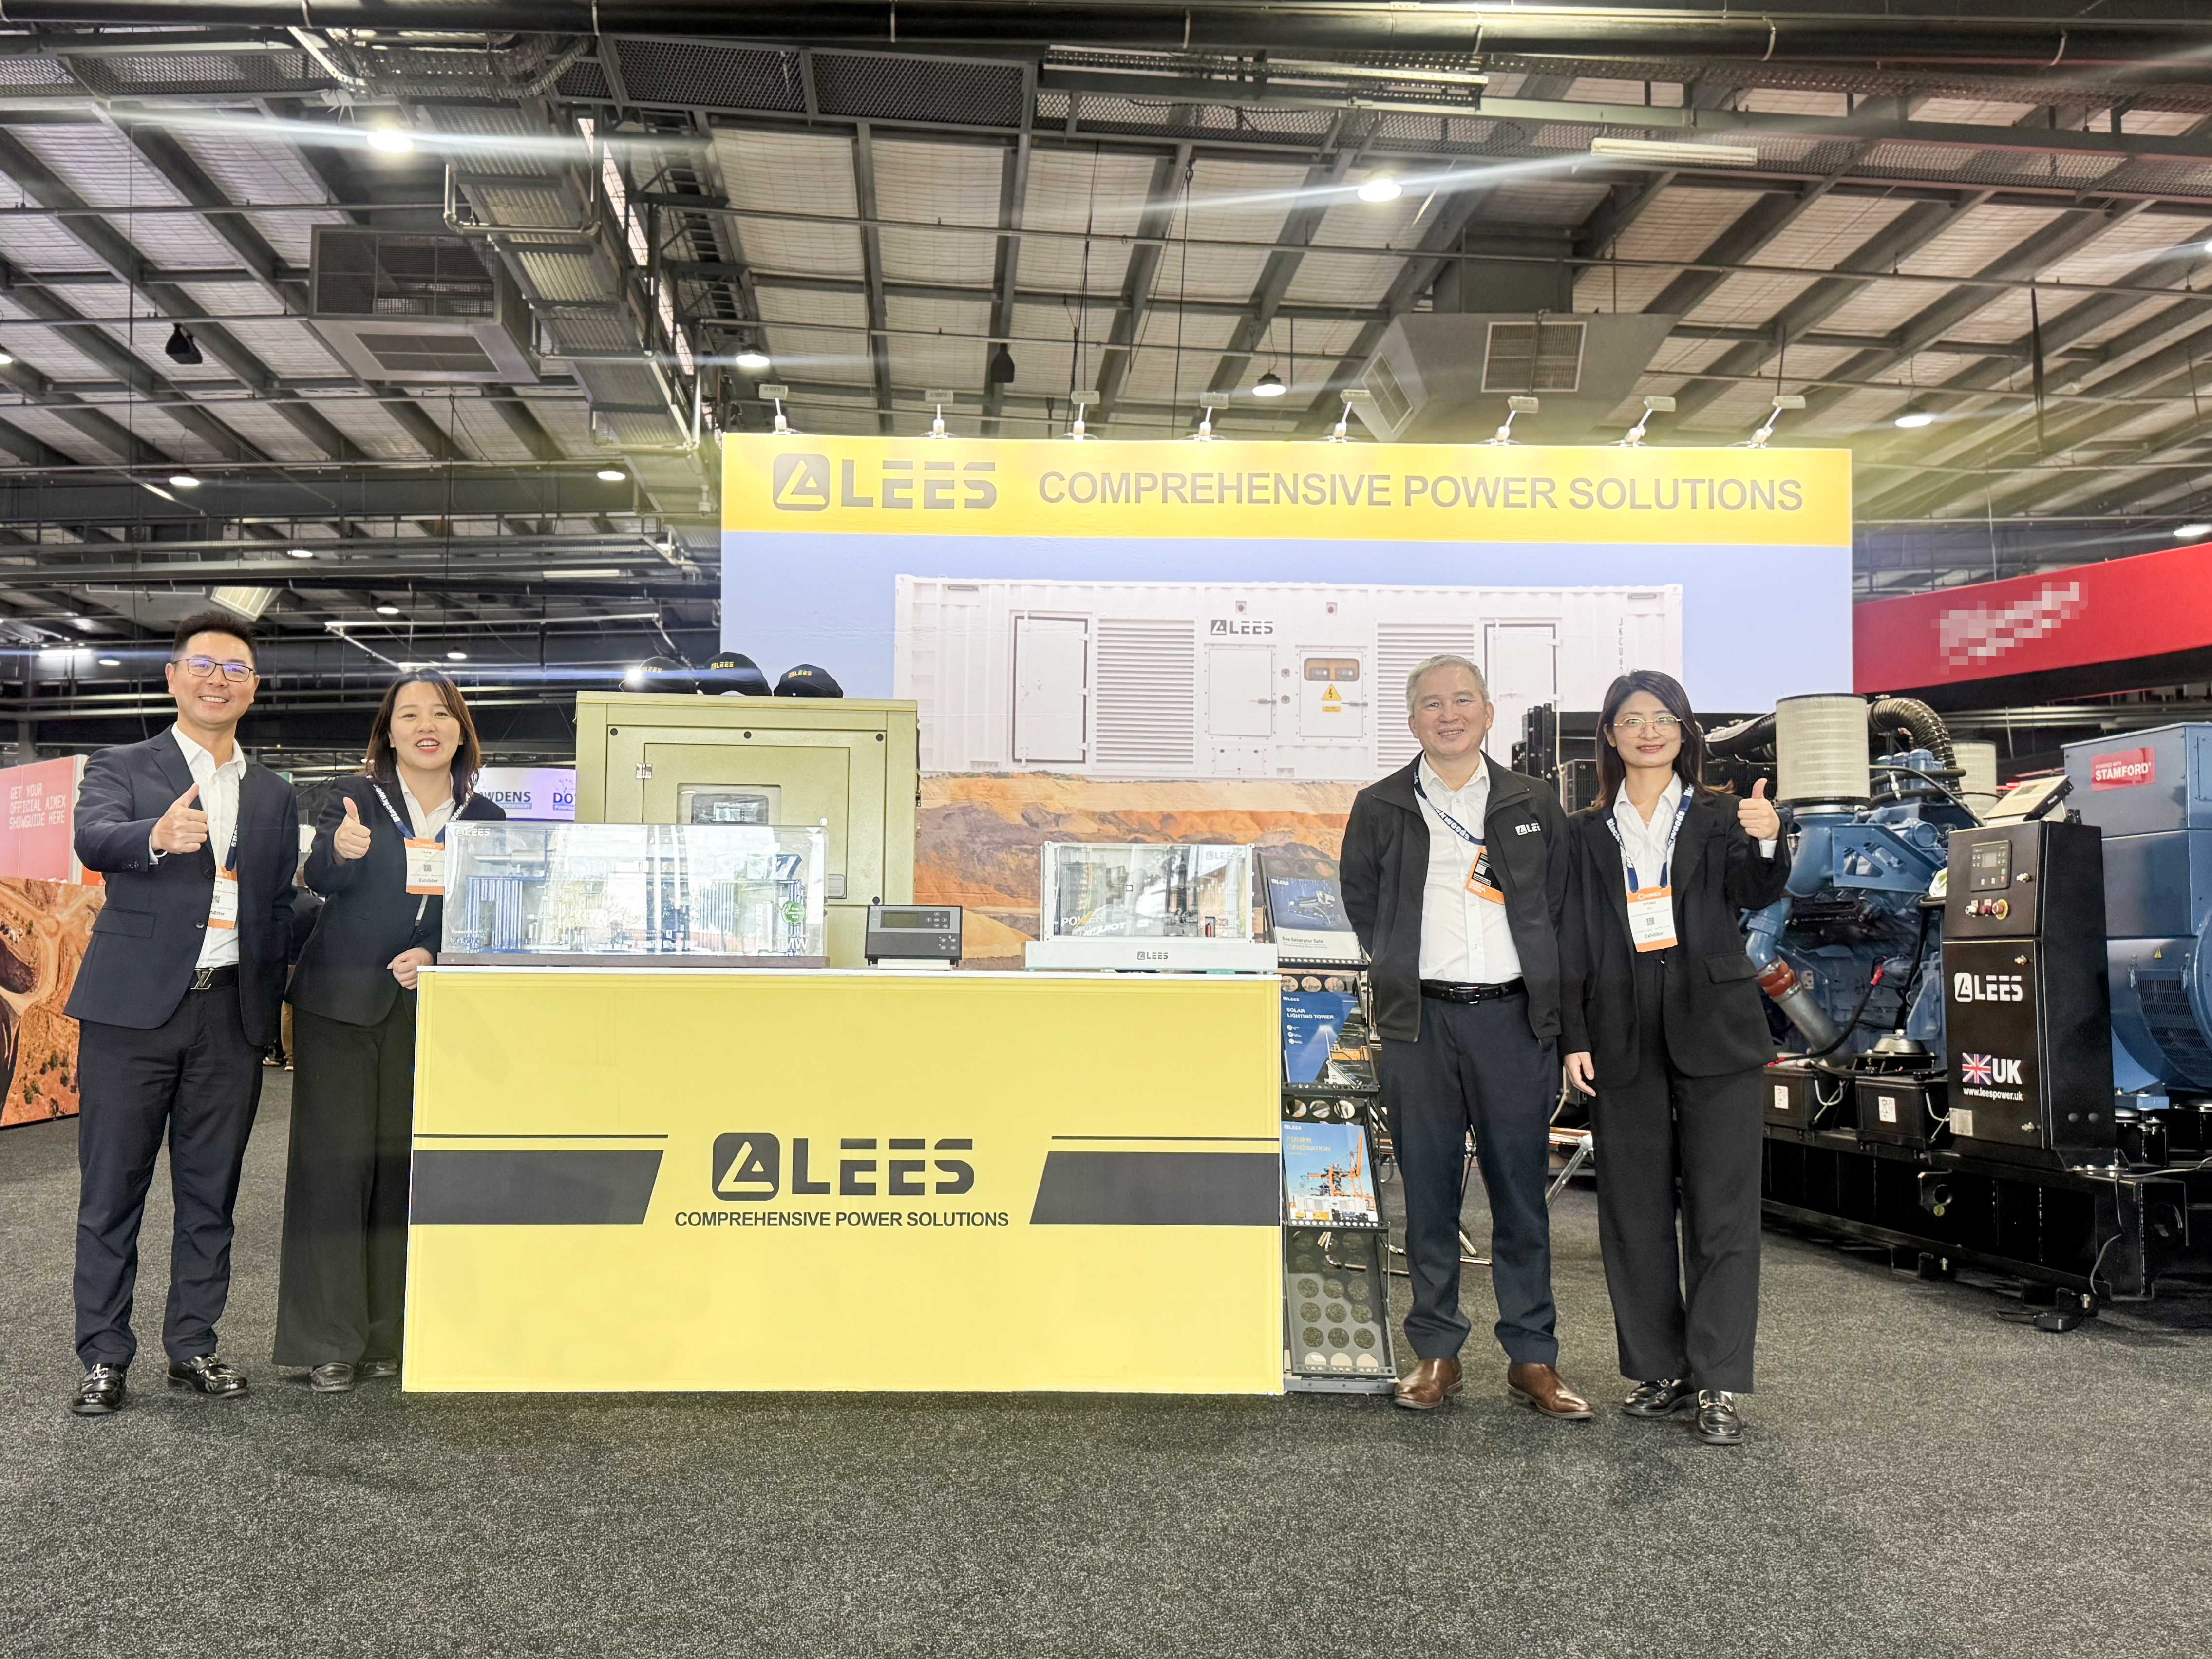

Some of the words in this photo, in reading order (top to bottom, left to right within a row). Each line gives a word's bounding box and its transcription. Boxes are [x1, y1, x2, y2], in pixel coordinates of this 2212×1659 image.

[1039, 471, 1391, 507] COMPREHENSIVE
[1404, 474, 1558, 509] POWER
[1569, 477, 1803, 512] SOLUTIONS
[2096, 762, 2149, 781] STAMFORD
[11, 786, 22, 800] GET
[27, 783, 42, 797] YOUR
[479, 792, 531, 803] WDENS
[10, 799, 41, 814] OFFICIAL
[45, 795, 66, 810] AIMEX
[9, 812, 45, 830] SHOWGUIDE
[49, 811, 65, 824] HERE
[1992, 1058, 2023, 1085] UK
[1963, 1087, 2023, 1102] www.leespower.uk
[675, 1211, 831, 1227] COMPREHENSIVE
[835, 1212, 902, 1227] POWER
[907, 1212, 1009, 1226] SOLUTIONS
